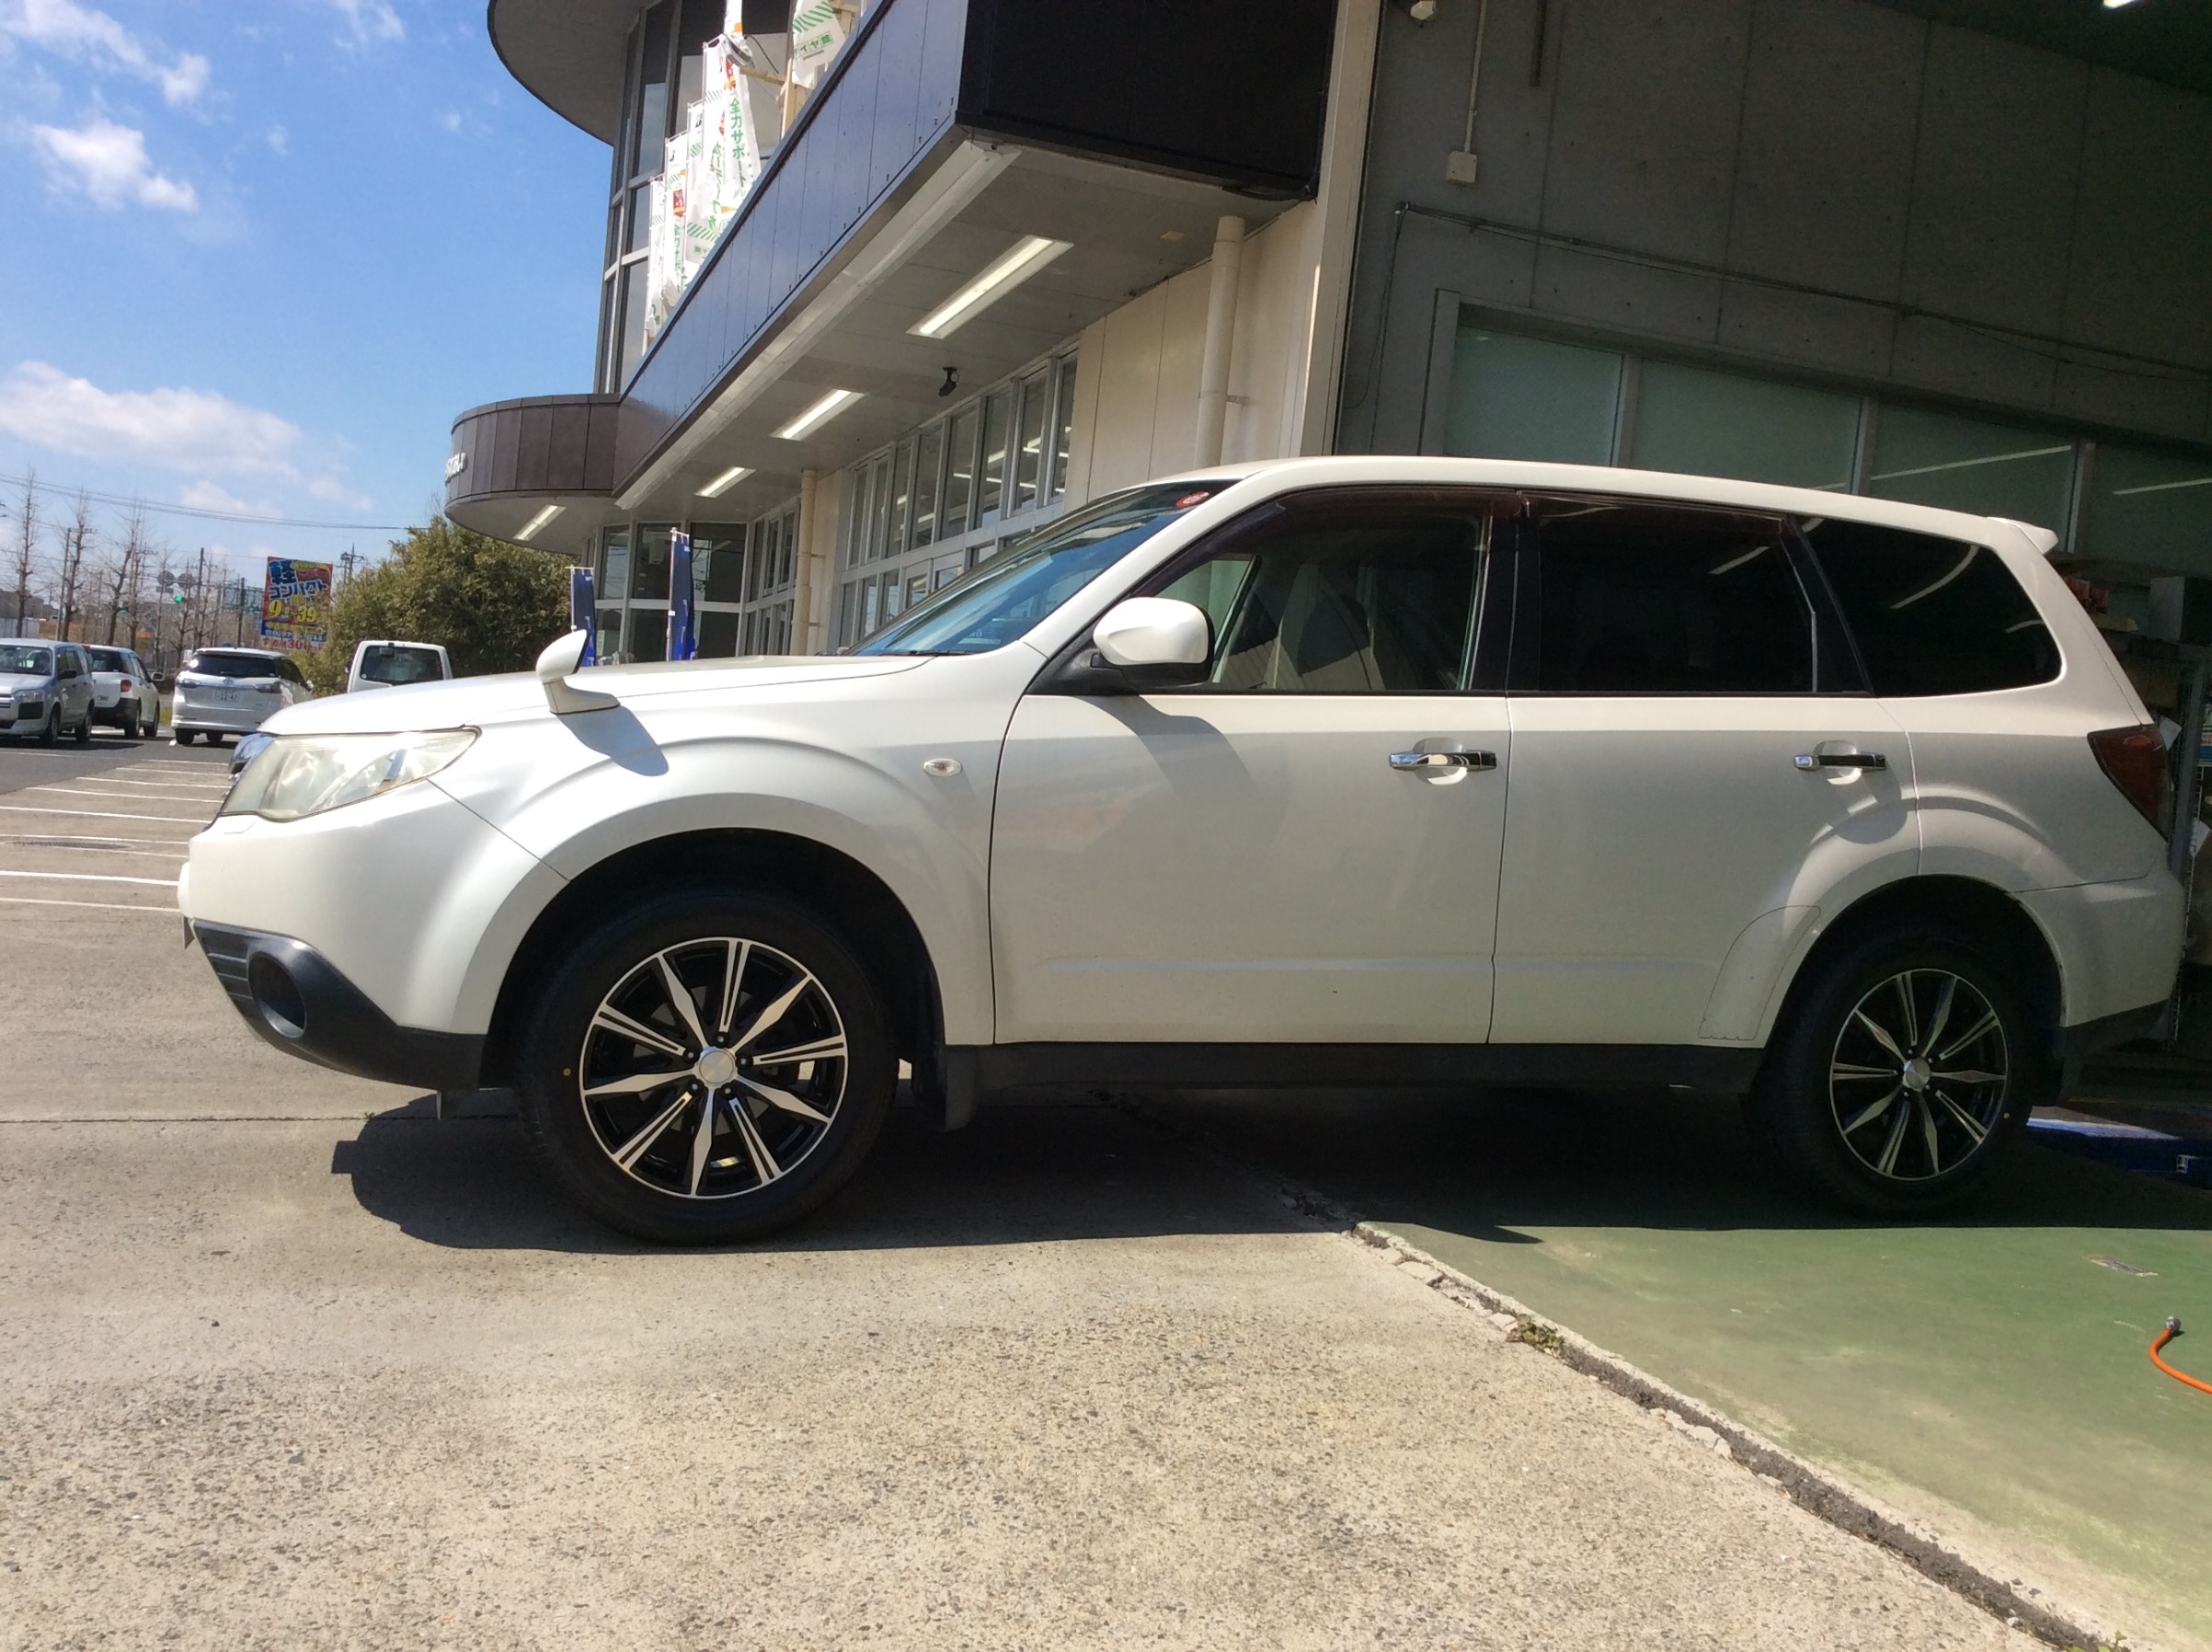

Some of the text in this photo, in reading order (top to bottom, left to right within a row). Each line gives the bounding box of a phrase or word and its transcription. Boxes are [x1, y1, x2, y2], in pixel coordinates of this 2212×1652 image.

[730, 98, 746, 188] 全力サポート
[269, 560, 297, 584] 軽
[268, 580, 327, 600] コンパクト
